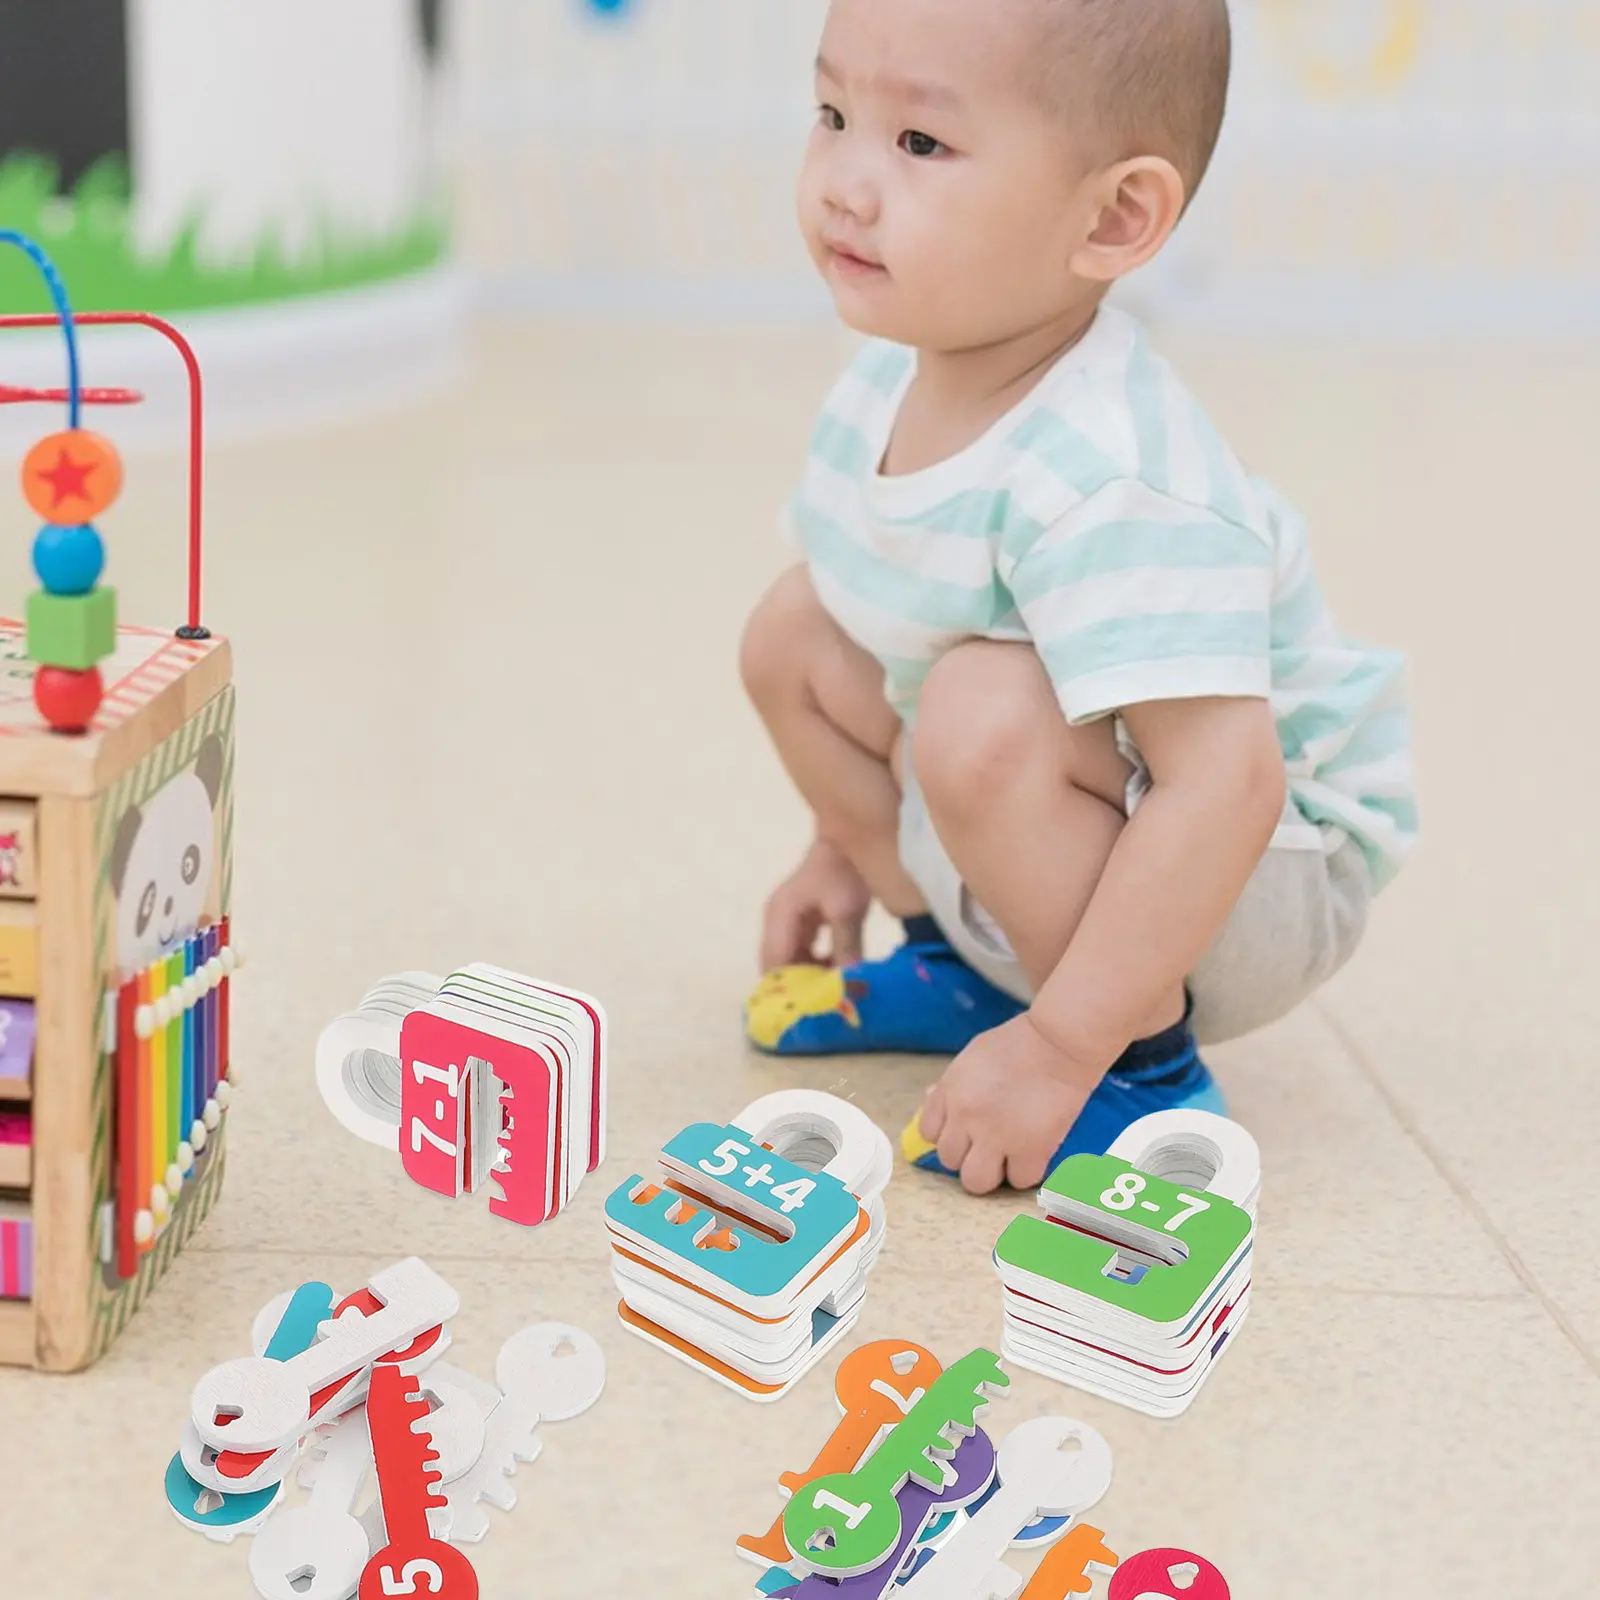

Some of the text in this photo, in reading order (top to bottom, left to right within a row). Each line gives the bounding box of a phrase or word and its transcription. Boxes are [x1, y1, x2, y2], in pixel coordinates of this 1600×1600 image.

[412, 1060, 459, 1157] 7-1
[698, 1139, 817, 1213] 5+4
[1100, 1173, 1211, 1232] 8-7
[812, 1489, 872, 1530] 1
[380, 1558, 443, 1596] 5
